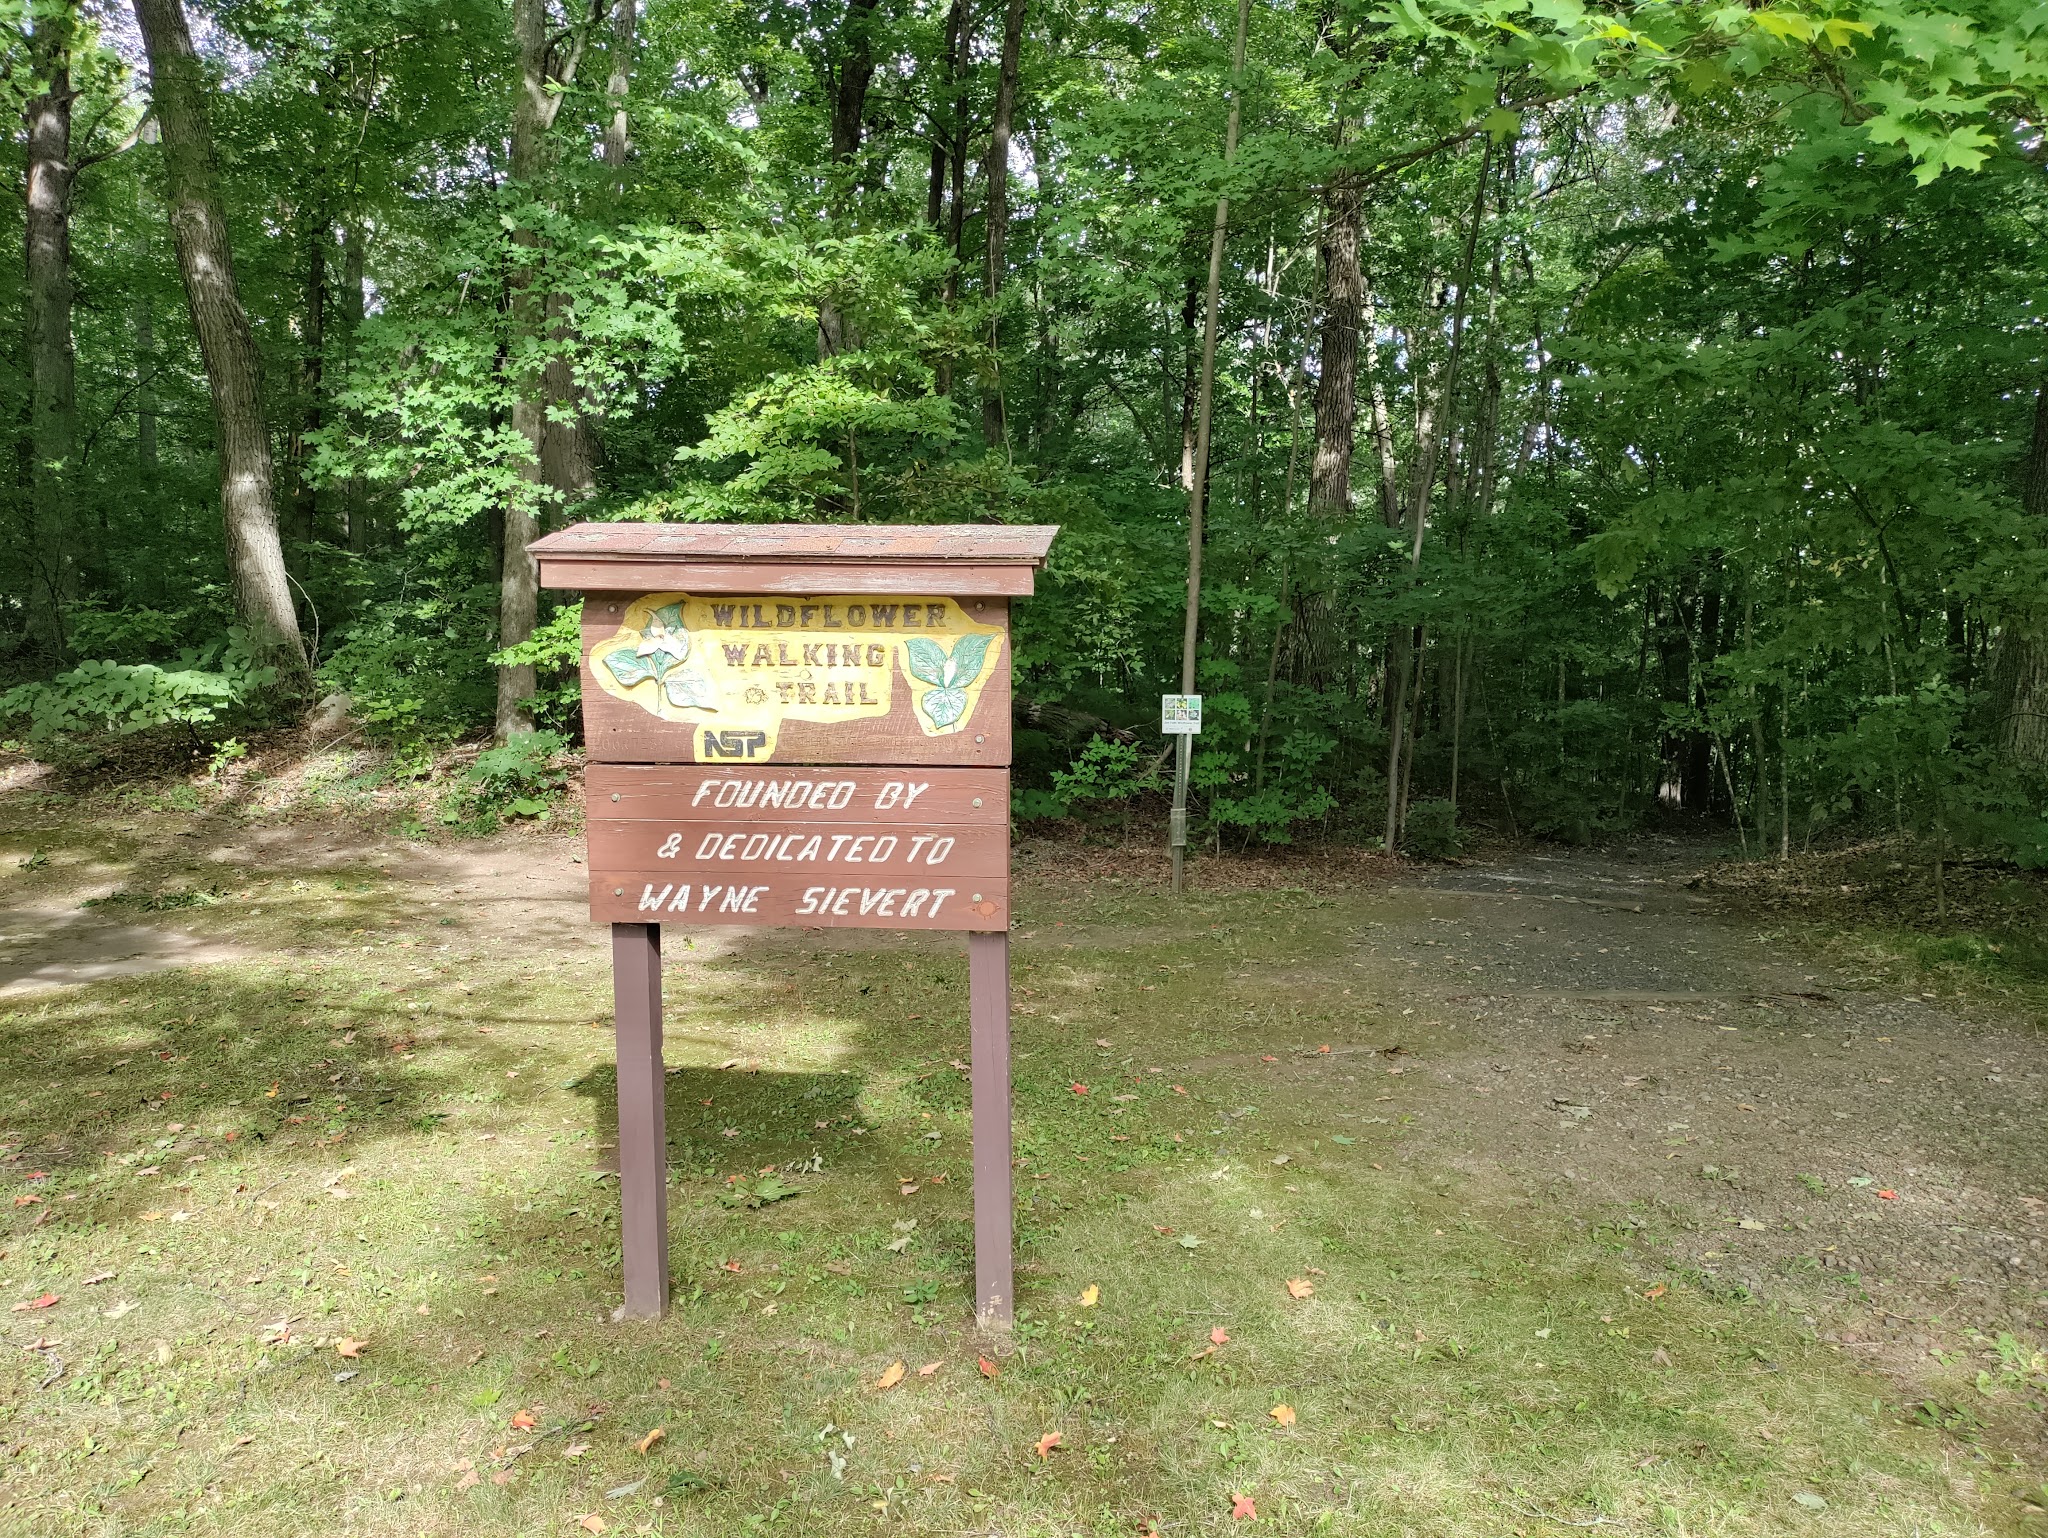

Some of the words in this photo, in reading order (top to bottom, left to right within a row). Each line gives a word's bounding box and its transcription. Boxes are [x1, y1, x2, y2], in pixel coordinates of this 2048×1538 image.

[711, 603, 947, 628] WILDFLOWER
[721, 643, 886, 668] WALKING
[775, 681, 879, 705] TRAIL
[703, 730, 767, 757] NSP
[691, 780, 857, 810] FOUNDED
[874, 782, 930, 810] BY
[656, 832, 684, 860] &
[695, 833, 899, 864] DEDICATED
[906, 835, 956, 866] TO
[637, 883, 770, 914] WAYNE
[795, 886, 957, 919] SIEVERT
